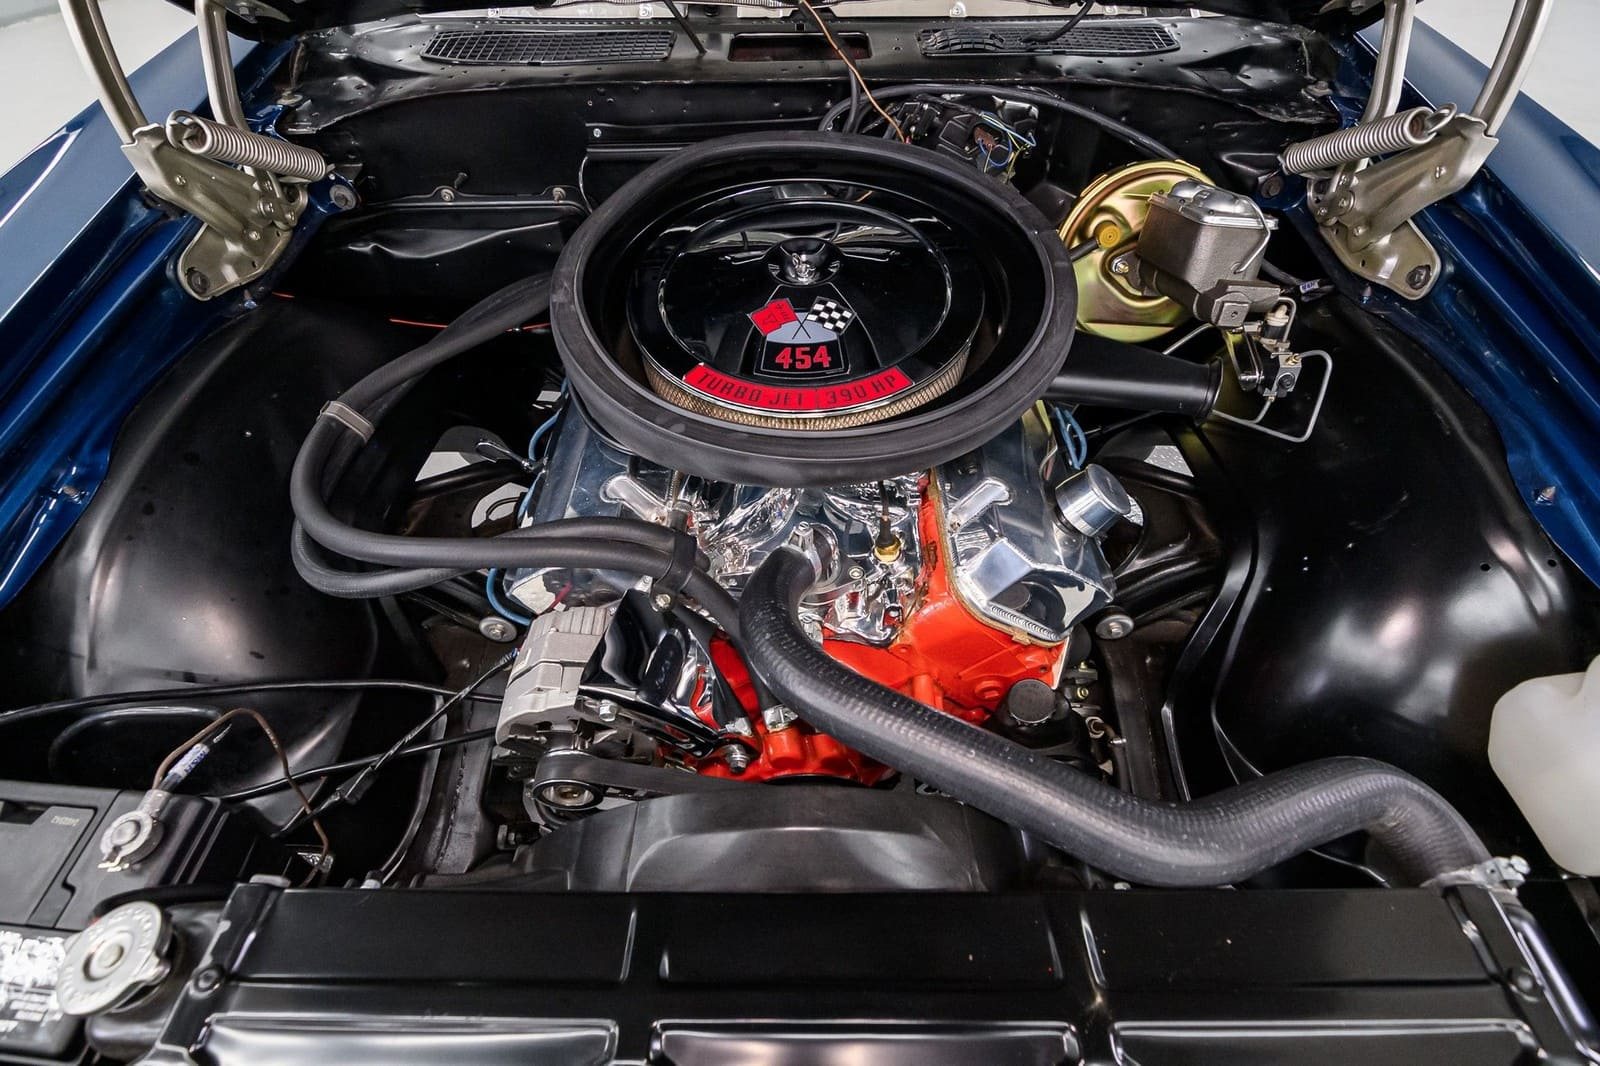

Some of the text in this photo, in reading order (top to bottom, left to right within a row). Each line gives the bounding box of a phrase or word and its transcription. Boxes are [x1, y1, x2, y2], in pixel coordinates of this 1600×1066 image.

[775, 345, 831, 369] 454
[697, 372, 762, 402] TURBO
[826, 384, 867, 404] 390
[871, 375, 896, 393] HP
